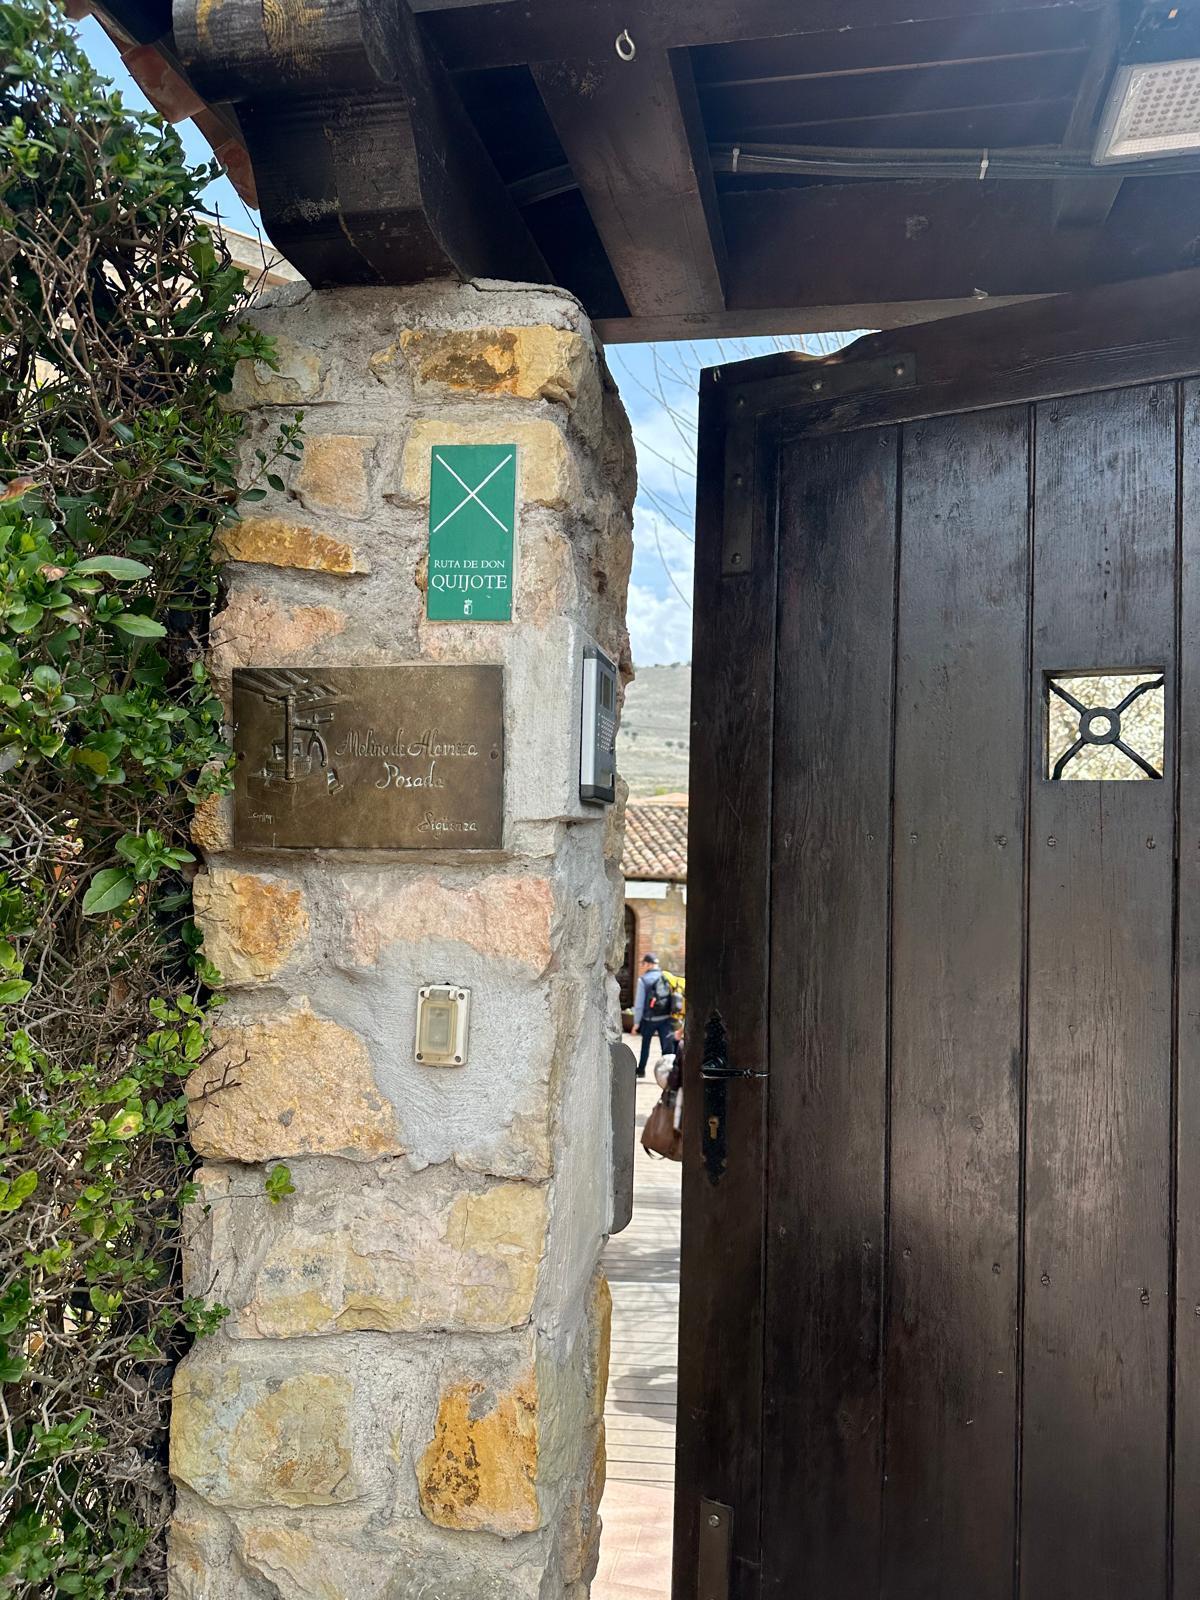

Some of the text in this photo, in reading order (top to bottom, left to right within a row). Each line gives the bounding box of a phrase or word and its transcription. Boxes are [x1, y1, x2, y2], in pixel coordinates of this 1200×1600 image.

[434, 560, 505, 568] RUTA DE DON
[431, 574, 507, 592] QUIJOTE
[335, 728, 389, 757] Molino
[391, 727, 406, 756] de
[375, 760, 444, 789] Posada
